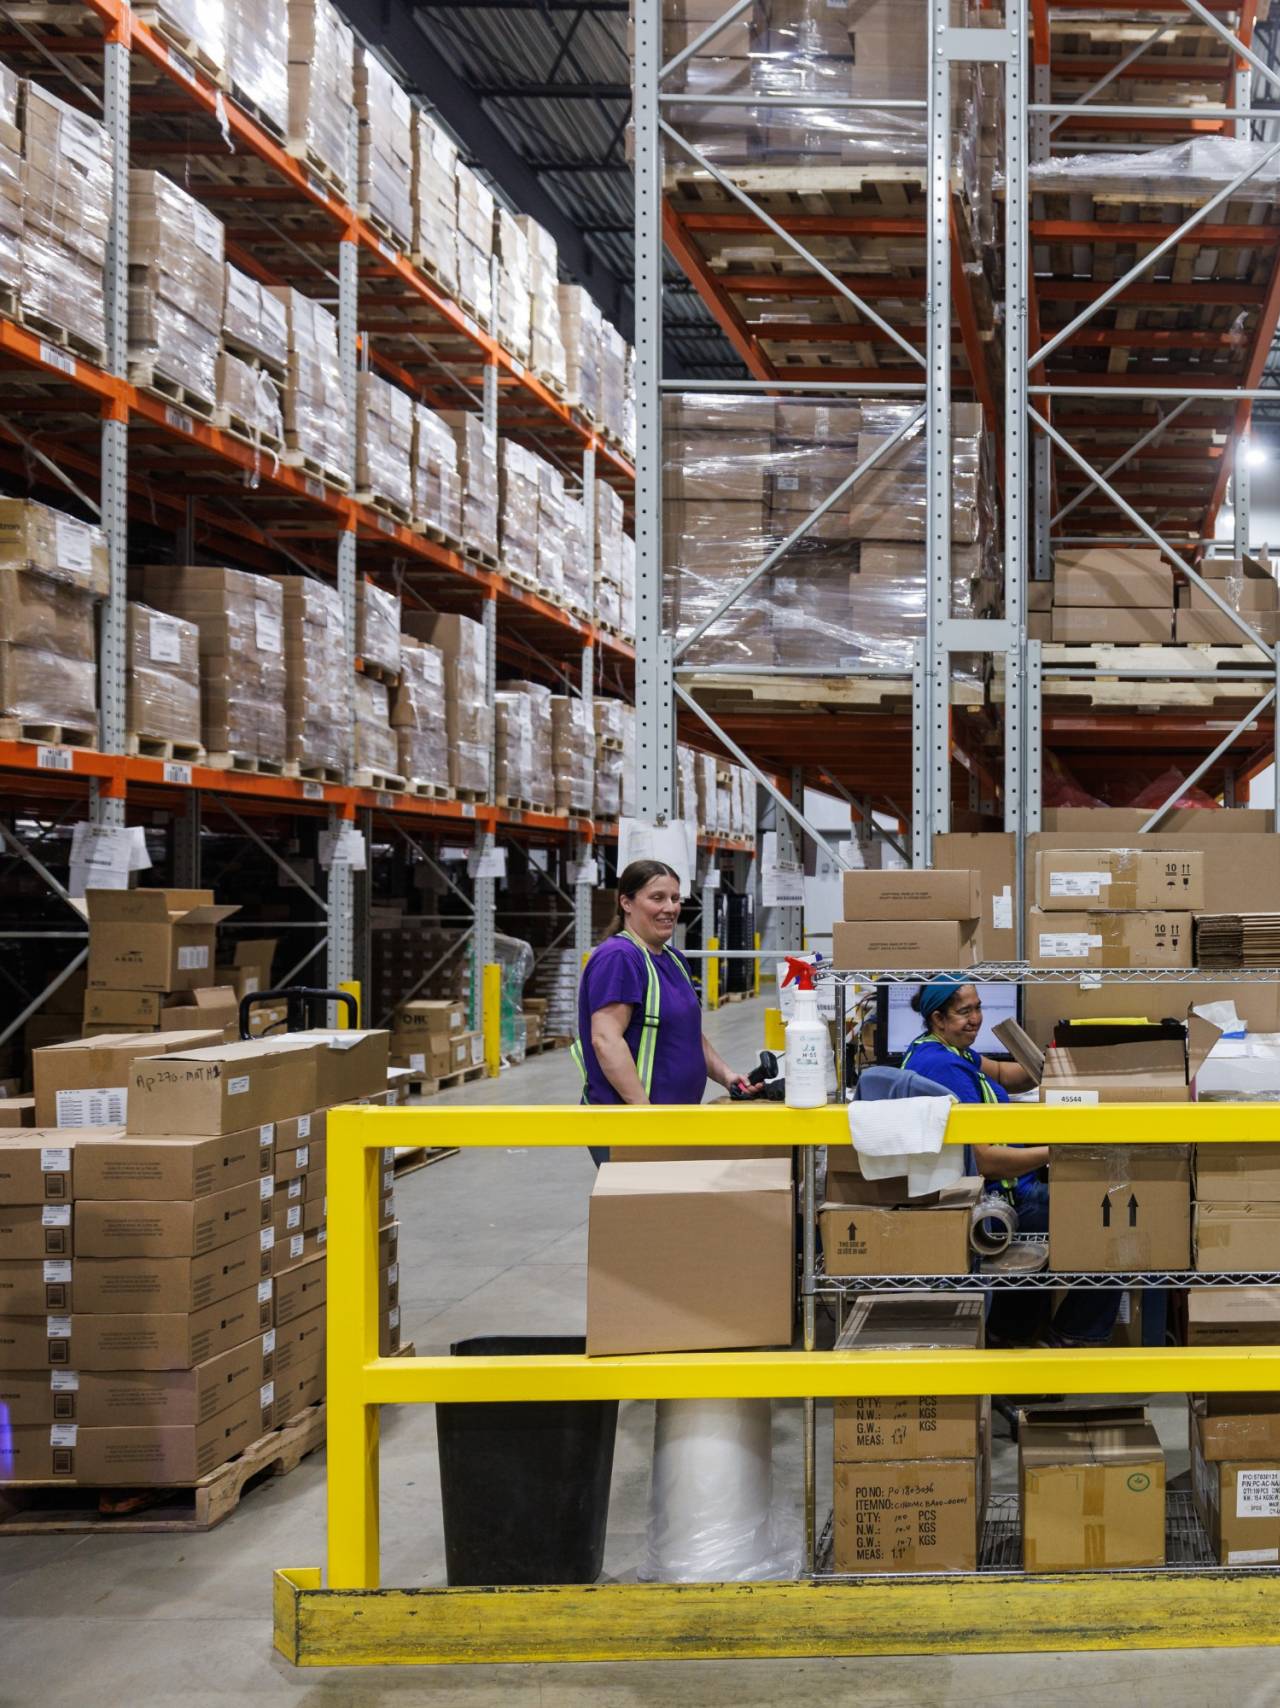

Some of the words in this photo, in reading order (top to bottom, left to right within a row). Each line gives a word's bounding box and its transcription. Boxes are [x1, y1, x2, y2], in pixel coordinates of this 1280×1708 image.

[1166, 864, 1176, 872] 10
[1155, 924, 1166, 932] 10
[920, 1408, 936, 1418] KGS
[920, 1421, 936, 1431] KGS
[857, 1435, 884, 1446] MEAS:
[918, 1510, 936, 1520] PCS
[918, 1522, 936, 1533] KGS
[919, 1535, 936, 1546] KGS
[856, 1549, 884, 1560] MEAS:
